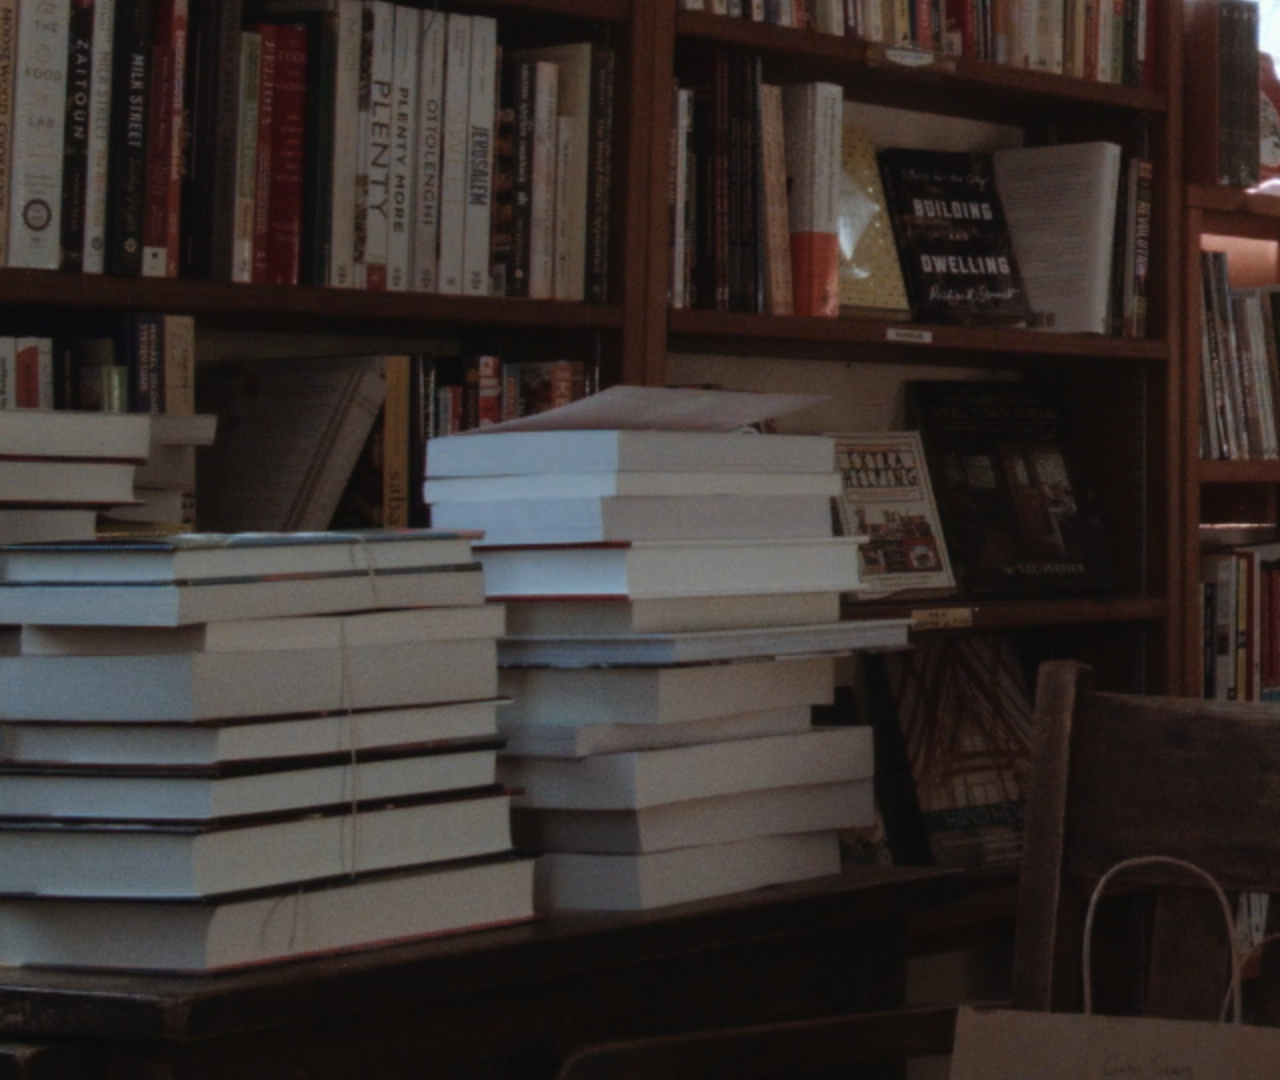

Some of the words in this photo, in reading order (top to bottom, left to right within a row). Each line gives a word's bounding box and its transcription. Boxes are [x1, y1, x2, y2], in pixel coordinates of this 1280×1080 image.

[24, 67, 63, 82] FOOD
[72, 38, 89, 141] ZAITOUN
[96, 50, 111, 86] MILK
[130, 53, 146, 90] MILK
[95, 90, 110, 141] STREET
[127, 95, 145, 150] STREET
[394, 86, 410, 166] PLENTY
[369, 79, 393, 221] PLENTY
[422, 98, 440, 227] OTTOLENGHI
[469, 124, 490, 207] JERUSALEM
[392, 174, 407, 234] MORE
[912, 197, 994, 222] BUILDING
[920, 253, 1011, 275] DWELLING
